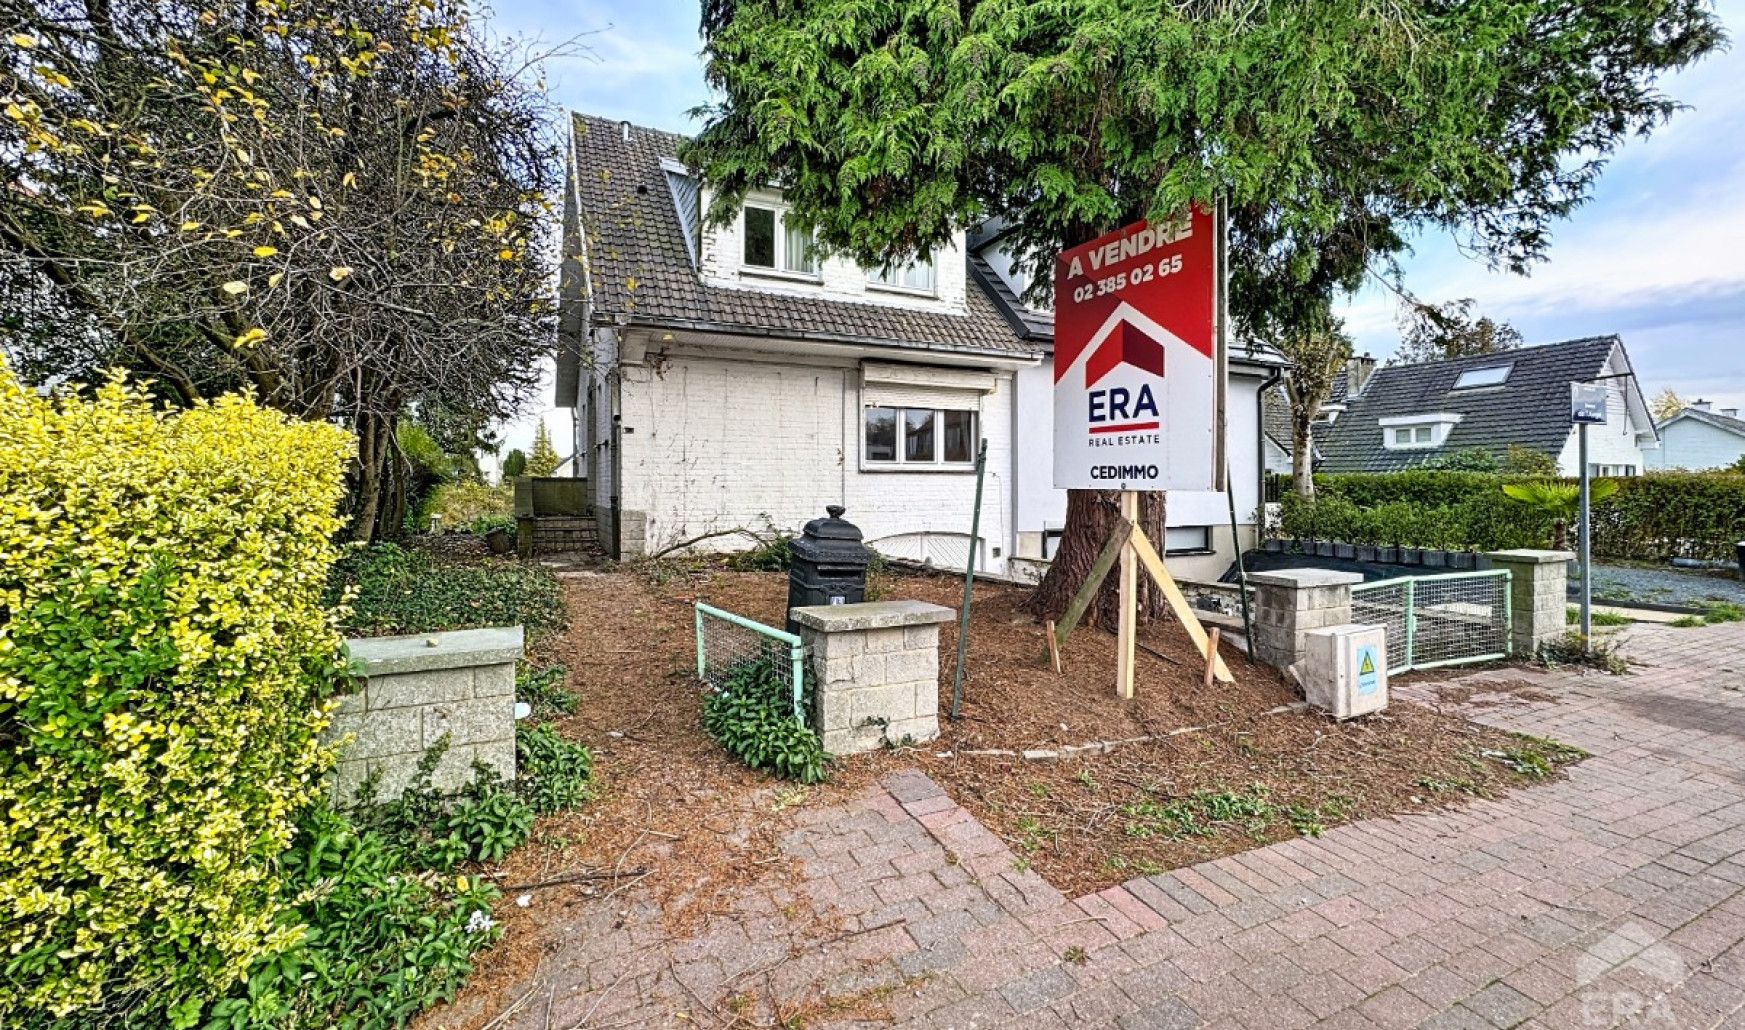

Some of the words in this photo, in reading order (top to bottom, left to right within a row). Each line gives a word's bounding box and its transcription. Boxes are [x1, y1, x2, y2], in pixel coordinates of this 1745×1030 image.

[1067, 255, 1084, 280] A
[1088, 210, 1193, 271] VENDRE
[1073, 283, 1094, 303] 02
[1096, 272, 1127, 297] 385
[1130, 263, 1154, 285] 02
[1158, 253, 1183, 277] 65
[1088, 383, 1160, 423] ERA
[1088, 437, 1114, 448] REAL
[1117, 434, 1160, 446] ESTATE
[1090, 464, 1159, 480] CEDIMMO
